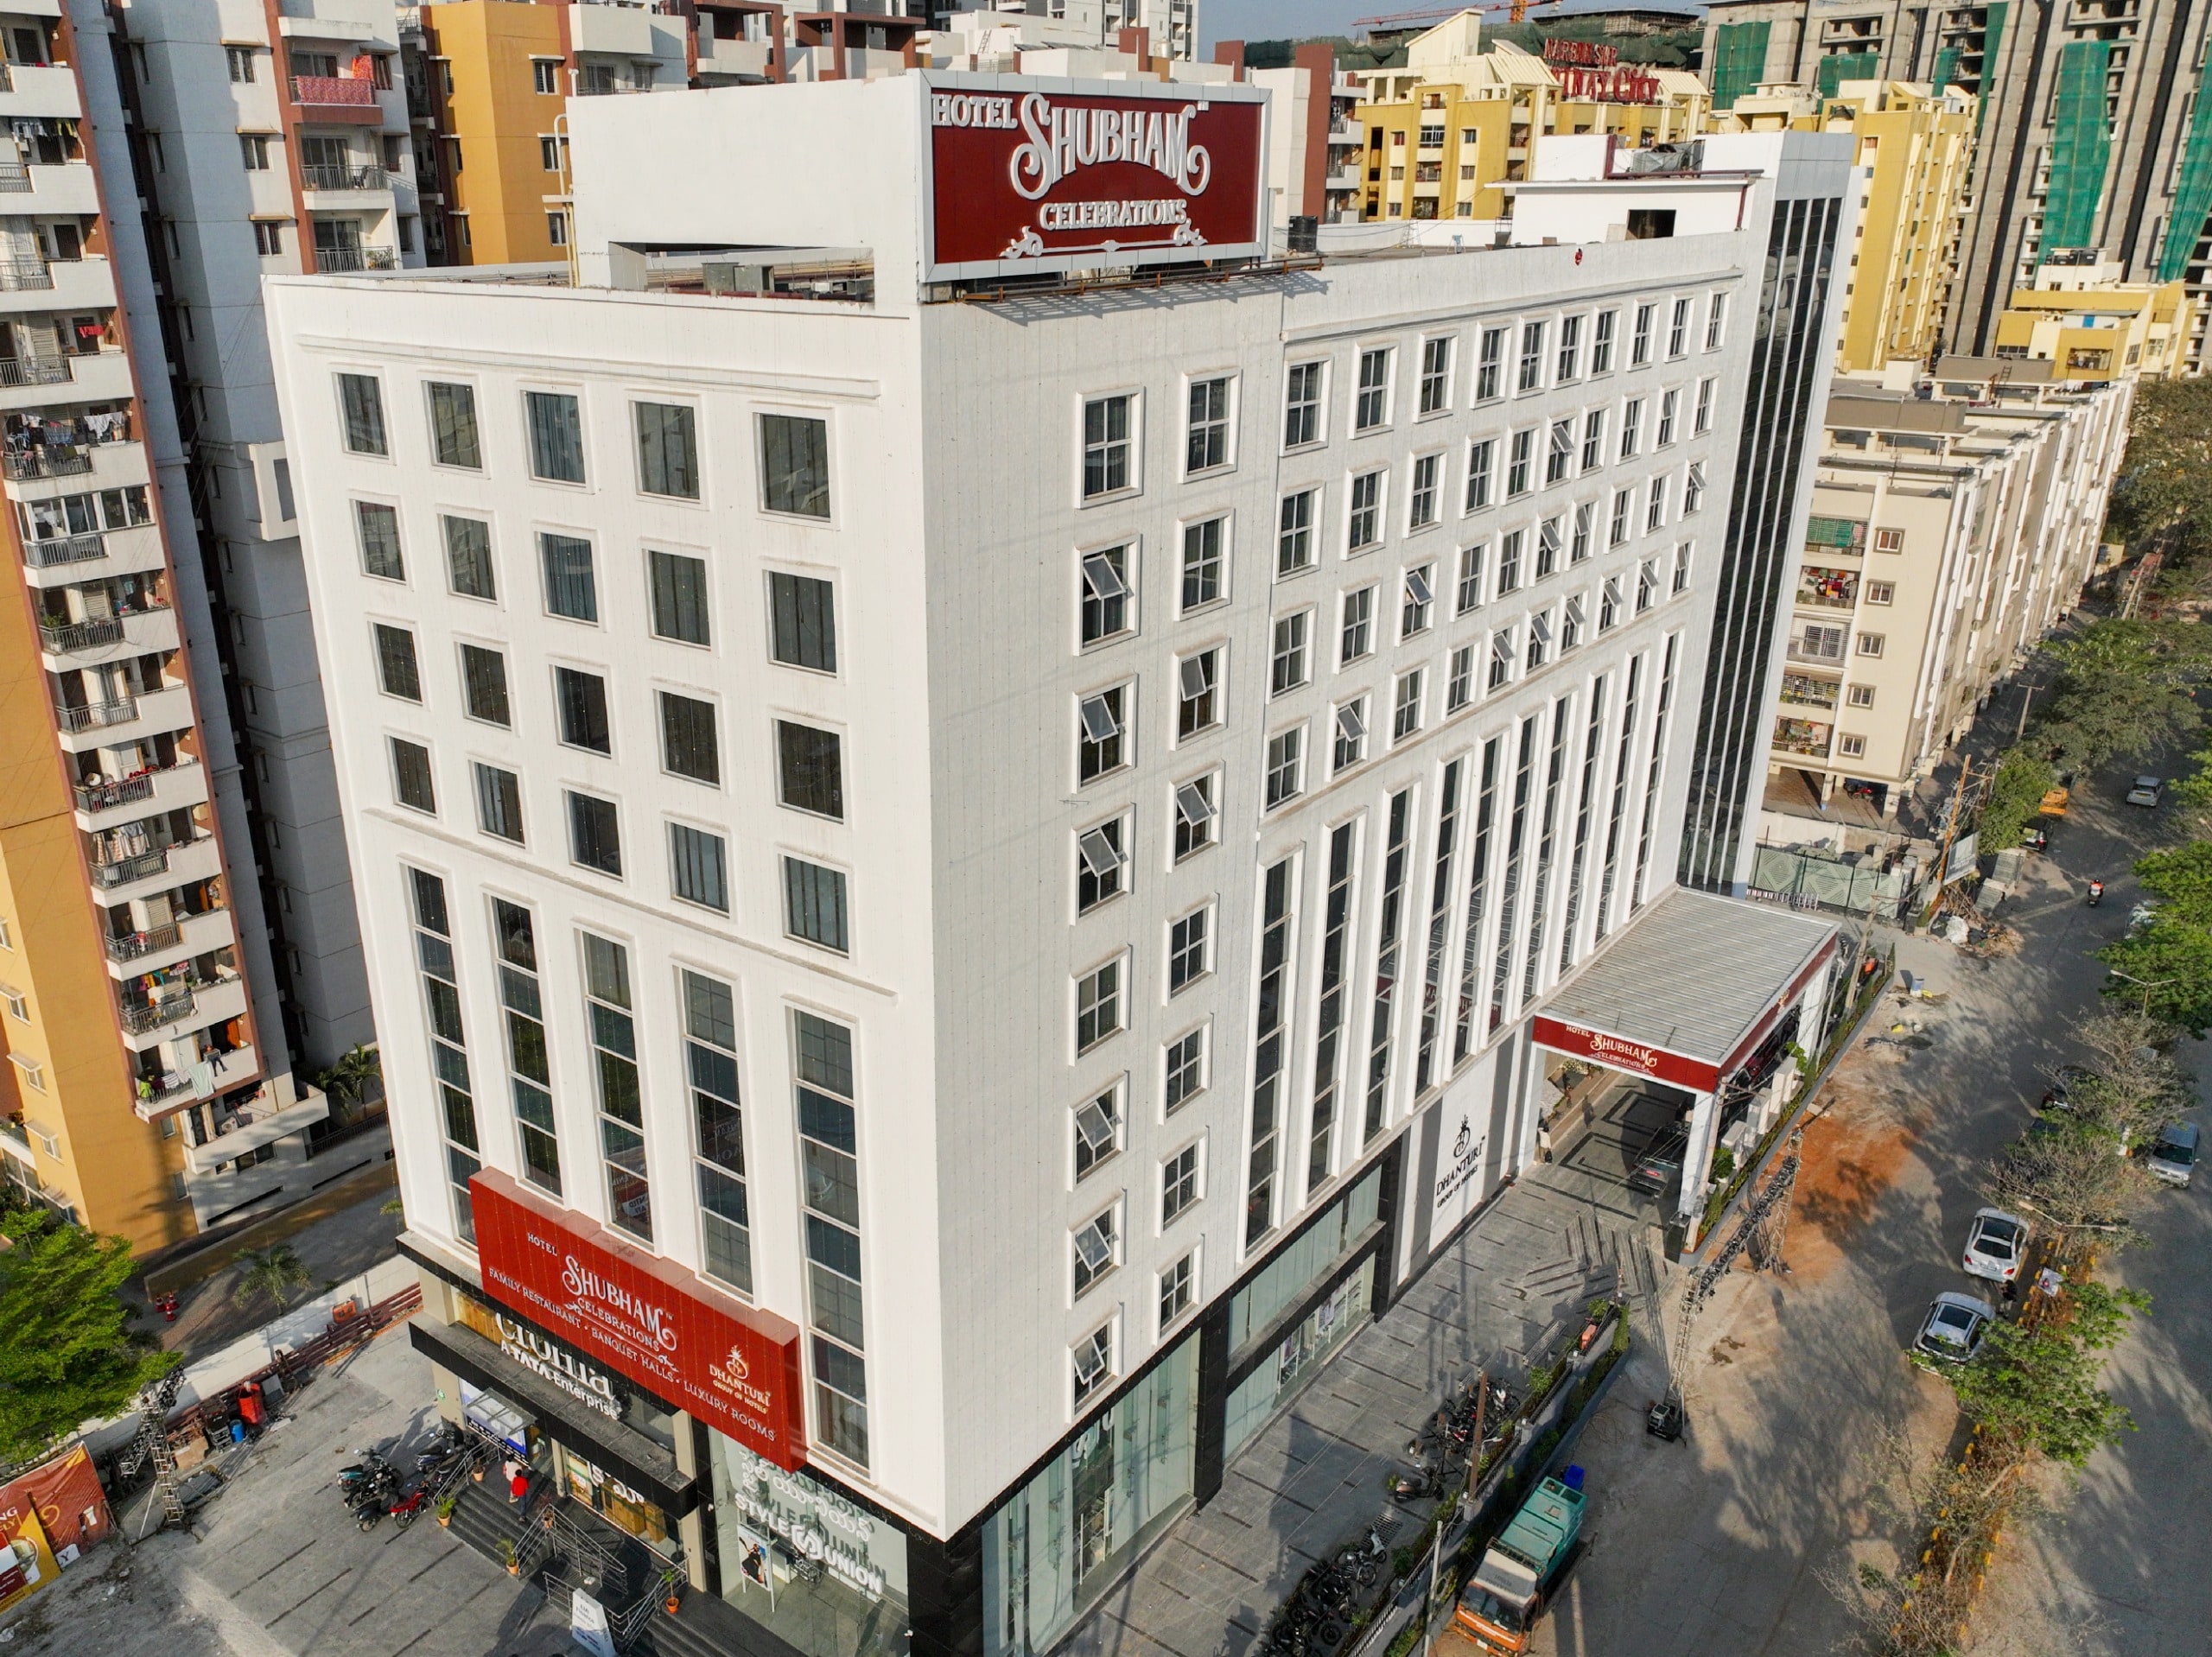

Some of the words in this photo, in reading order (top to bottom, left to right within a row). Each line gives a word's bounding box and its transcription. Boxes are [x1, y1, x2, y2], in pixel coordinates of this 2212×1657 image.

[931, 92, 1019, 130] HOTEL
[1010, 92, 1211, 200] SHUBHAM
[1039, 198, 1188, 232] CELEBRATIONS
[1566, 1025, 1591, 1038] HOTEL
[1590, 1034, 1657, 1068] SHUBHAM
[1436, 1143, 1483, 1197] DHANTURI
[528, 1232, 558, 1257] HOTEL
[562, 1254, 677, 1352] SHUBHAM
[576, 1297, 660, 1353] CELEBRATIONS
[489, 1267, 521, 1293] FAMILY
[523, 1285, 582, 1330] RESTAURANT
[591, 1326, 639, 1362] BANQUET
[641, 1356, 675, 1383] HALLS
[683, 1380, 728, 1414] LUXURY
[731, 1406, 776, 1443] ROOMS
[500, 1339, 511, 1355] A
[510, 1344, 556, 1382] TATA
[553, 1370, 620, 1421] Enterprise
[709, 1363, 771, 1407] DHANTURI
[734, 1491, 791, 1538] STYLE
[823, 1544, 884, 1596] UNION
